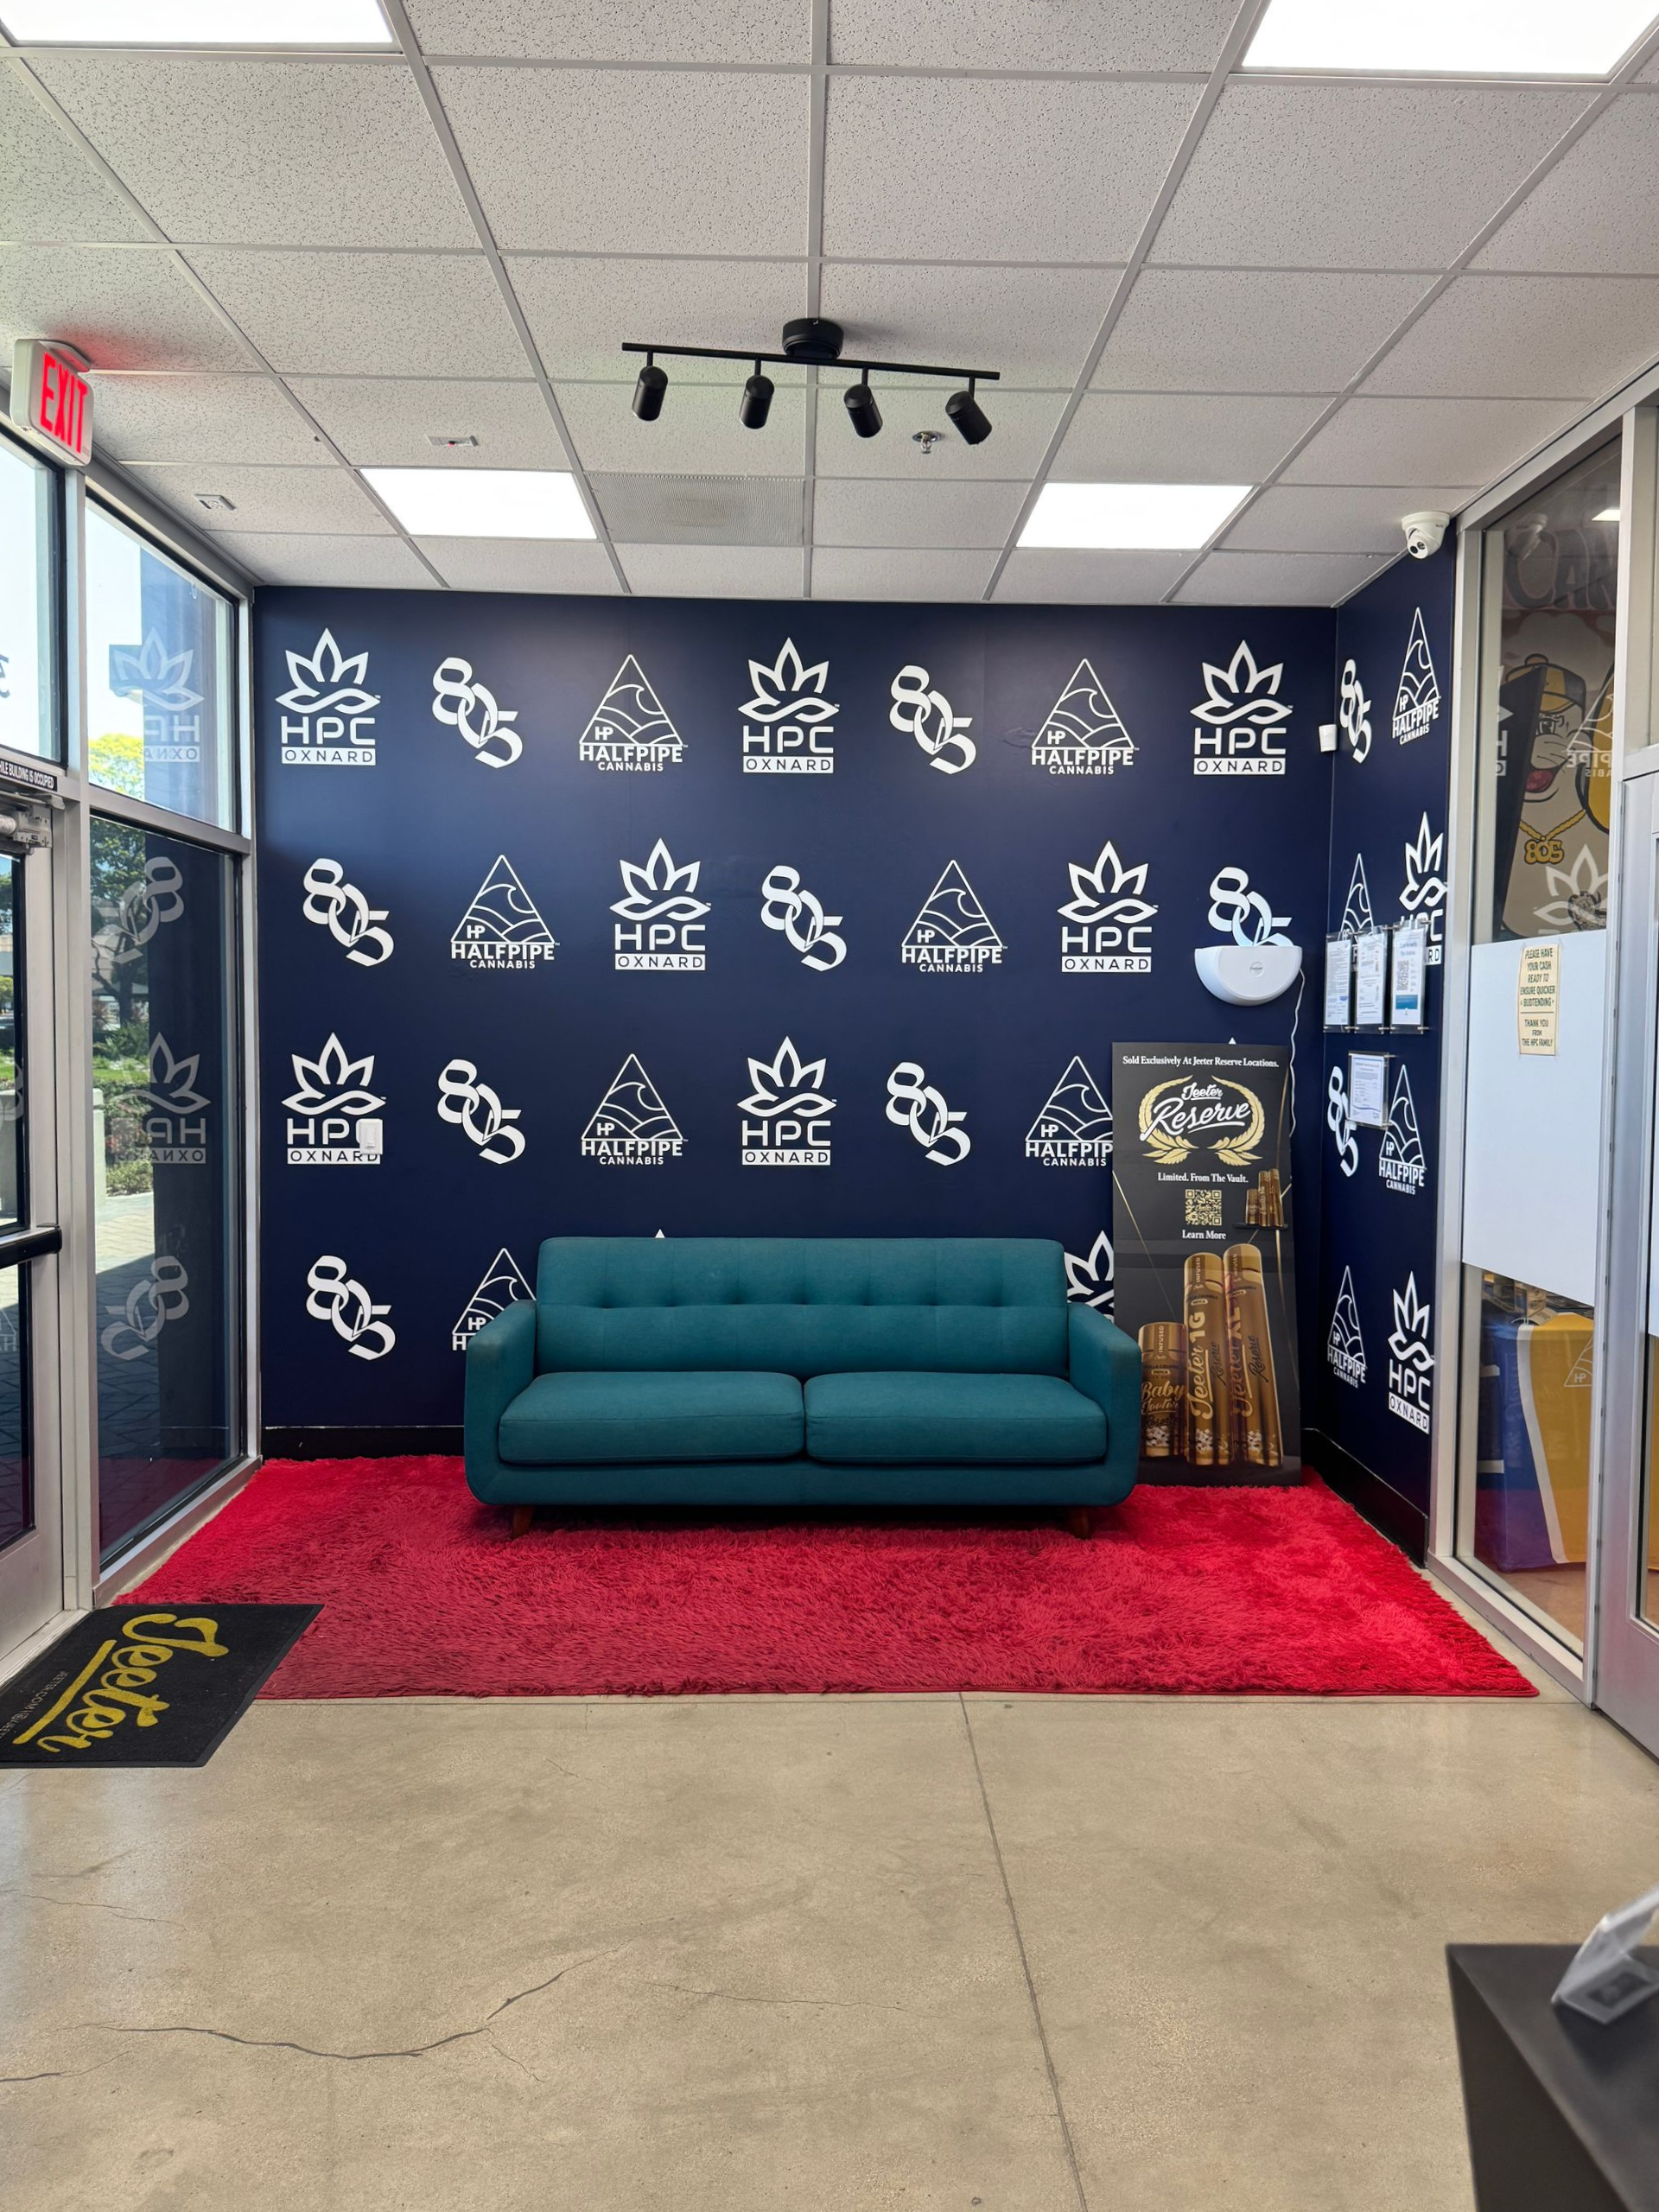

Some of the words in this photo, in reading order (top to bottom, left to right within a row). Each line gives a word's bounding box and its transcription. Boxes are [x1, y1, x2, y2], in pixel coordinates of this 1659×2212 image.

[40, 351, 87, 454] EXIT
[432, 658, 523, 768] 805
[890, 665, 976, 774] 805
[1393, 699, 1440, 739] HALFPIPE
[281, 716, 375, 745] HPC
[743, 726, 834, 753] HPC
[1400, 723, 1430, 745] CANNABIS
[1194, 728, 1286, 754] HPC
[283, 748, 375, 764] OXNARD
[579, 744, 683, 762] HALFPIPE
[1032, 748, 1134, 766] HALFPIPE
[597, 761, 664, 772] CANNABIS
[744, 757, 832, 772] OXNARD
[1049, 765, 1116, 775] CANNABIS
[1195, 759, 1284, 773] OXNARD
[9, 764, 29, 781] BUILDING
[29, 769, 34, 783] IS
[34, 772, 54, 789] OCCUPIED
[1524, 840, 1564, 864] 805
[303, 858, 393, 966] 805
[761, 866, 847, 971] 805
[615, 924, 705, 950] HPC
[1062, 926, 1152, 952] HPC
[451, 943, 555, 960] HALFPIPE
[901, 947, 1003, 964] HALFPIPE
[1525, 949, 1540, 959] PLEASE
[1541, 948, 1553, 957] HAVE
[470, 960, 536, 969] CANNABIS
[617, 955, 704, 969] OXNARD
[919, 963, 983, 973] CANNABIS
[1064, 957, 1150, 971] OXNARD
[1527, 962, 1539, 971] YOUR
[1539, 961, 1552, 970] CASH
[1528, 974, 1542, 983] READY
[1543, 973, 1549, 982] TO
[1520, 987, 1536, 995] ENSURE
[1536, 985, 1555, 995] QUICKER
[1524, 1019, 1539, 1027] THANK
[1540, 1019, 1548, 1027] YOU
[1539, 1039, 1553, 1047] FAMILY
[1122, 1055, 1140, 1065] Sold
[1141, 1056, 1181, 1067] Exclusively
[1182, 1056, 1192, 1065] At
[1192, 1057, 1213, 1066] Jeeter
[1215, 1057, 1243, 1066] Reserve
[1243, 1058, 1280, 1068] Locations.
[1181, 1082, 1224, 1101] Jeeter
[438, 1059, 525, 1164] 805
[886, 1062, 970, 1166] 805
[1140, 1097, 1251, 1141] Reserve
[288, 1118, 361, 1144] HP
[742, 1121, 830, 1146] HPC
[289, 1150, 381, 1163] OXNARD
[582, 1140, 683, 1156] HALFPIPE
[743, 1150, 830, 1164] OXNARD
[1026, 1141, 1113, 1158] HALFPIP
[600, 1156, 664, 1166] CANNABIS
[1043, 1158, 1107, 1166] CANNABIS
[1157, 1172, 1189, 1182] Limited.
[1190, 1173, 1210, 1183] From
[1211, 1173, 1225, 1183] The
[1226, 1173, 1249, 1183] Vault.
[1379, 1160, 1425, 1186] HALFPIPE
[1386, 1179, 1416, 1195] CANNABIS
[1182, 1230, 1205, 1239] Learn
[1205, 1230, 1227, 1240] More
[307, 1255, 395, 1360] 805
[1189, 1311, 1206, 1343] 1G
[1249, 1335, 1269, 1383] Reserve
[1327, 1345, 1366, 1383] HALFPIPE
[1187, 1345, 1213, 1421] Jeeter
[1333, 1367, 1359, 1389] CANNABIS
[1389, 1359, 1430, 1411] HPC
[1141, 1381, 1185, 1404] Baby
[1389, 1395, 1429, 1431] OXNARD
[37, 1612, 229, 1753] Jeeter
